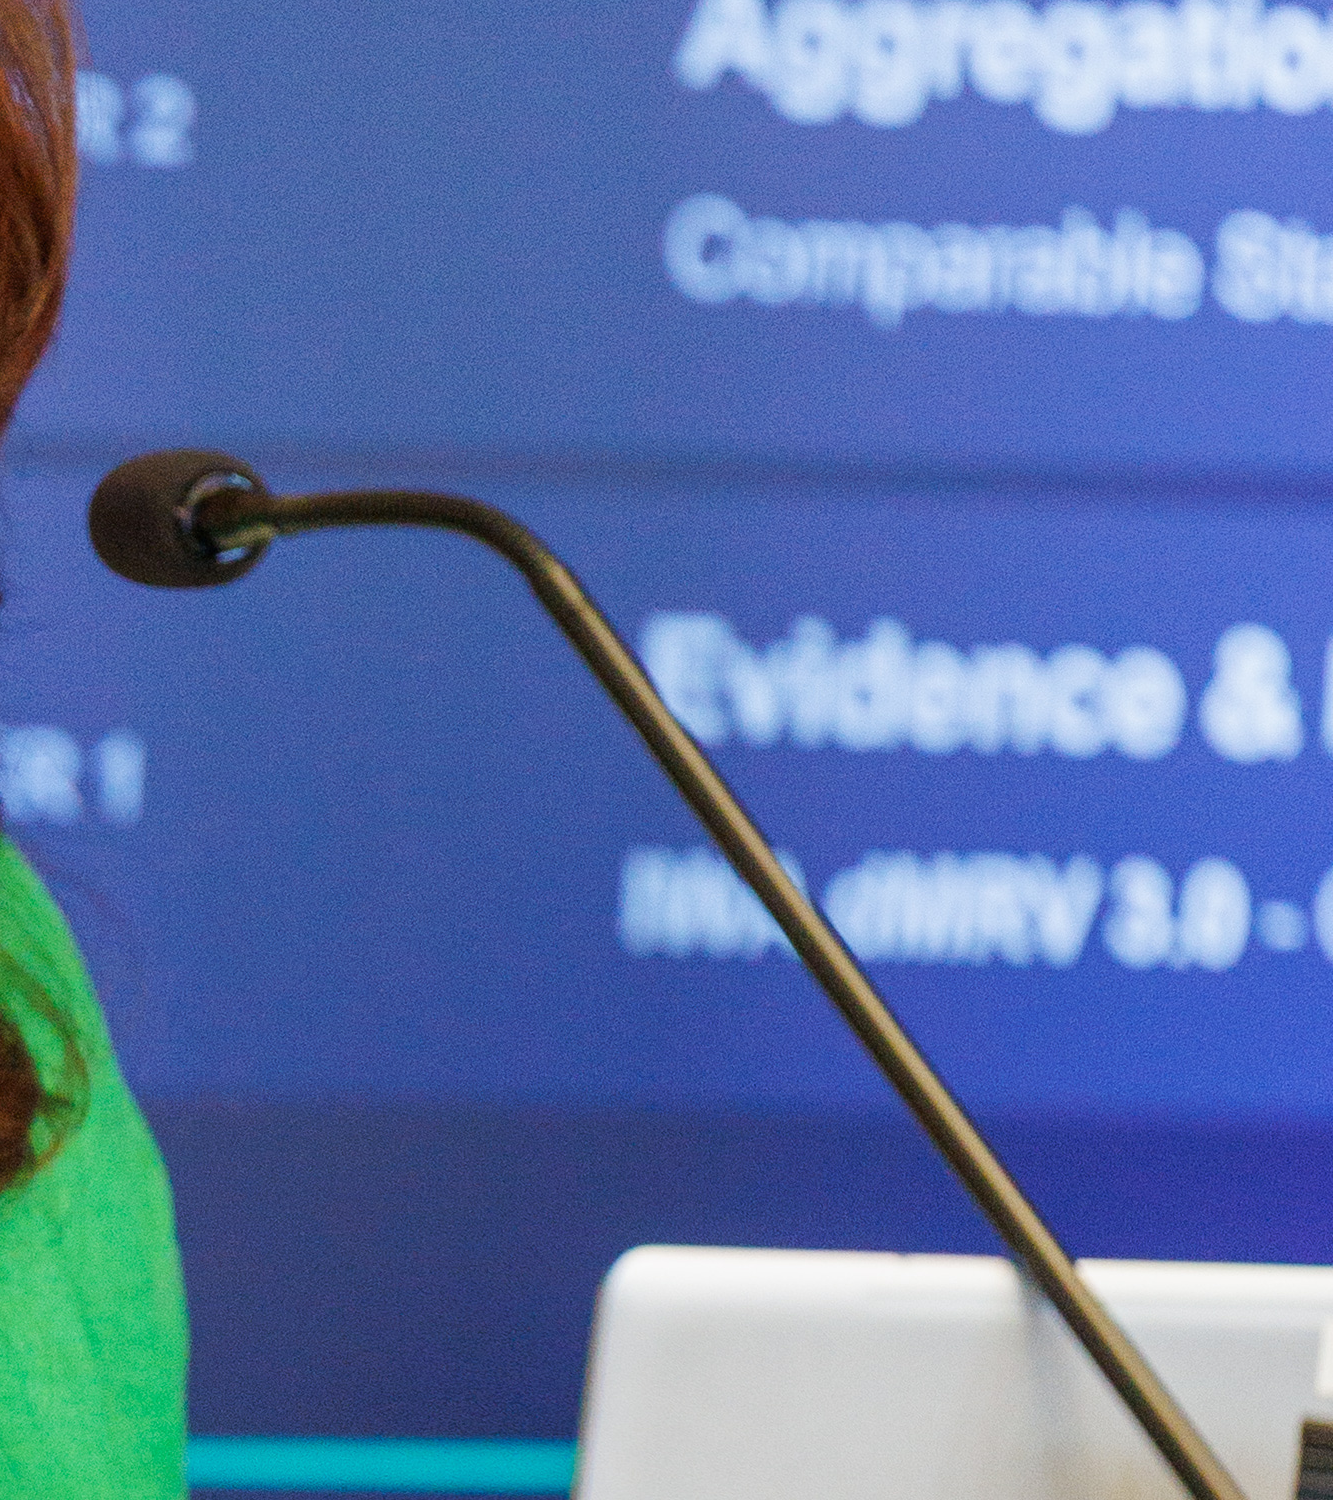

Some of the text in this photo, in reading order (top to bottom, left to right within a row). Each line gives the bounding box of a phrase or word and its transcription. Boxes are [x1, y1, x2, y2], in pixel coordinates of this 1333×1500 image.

[661, 192, 1204, 331] Comparable
[639, 611, 1186, 762] Evidence
[1199, 622, 1305, 764] &
